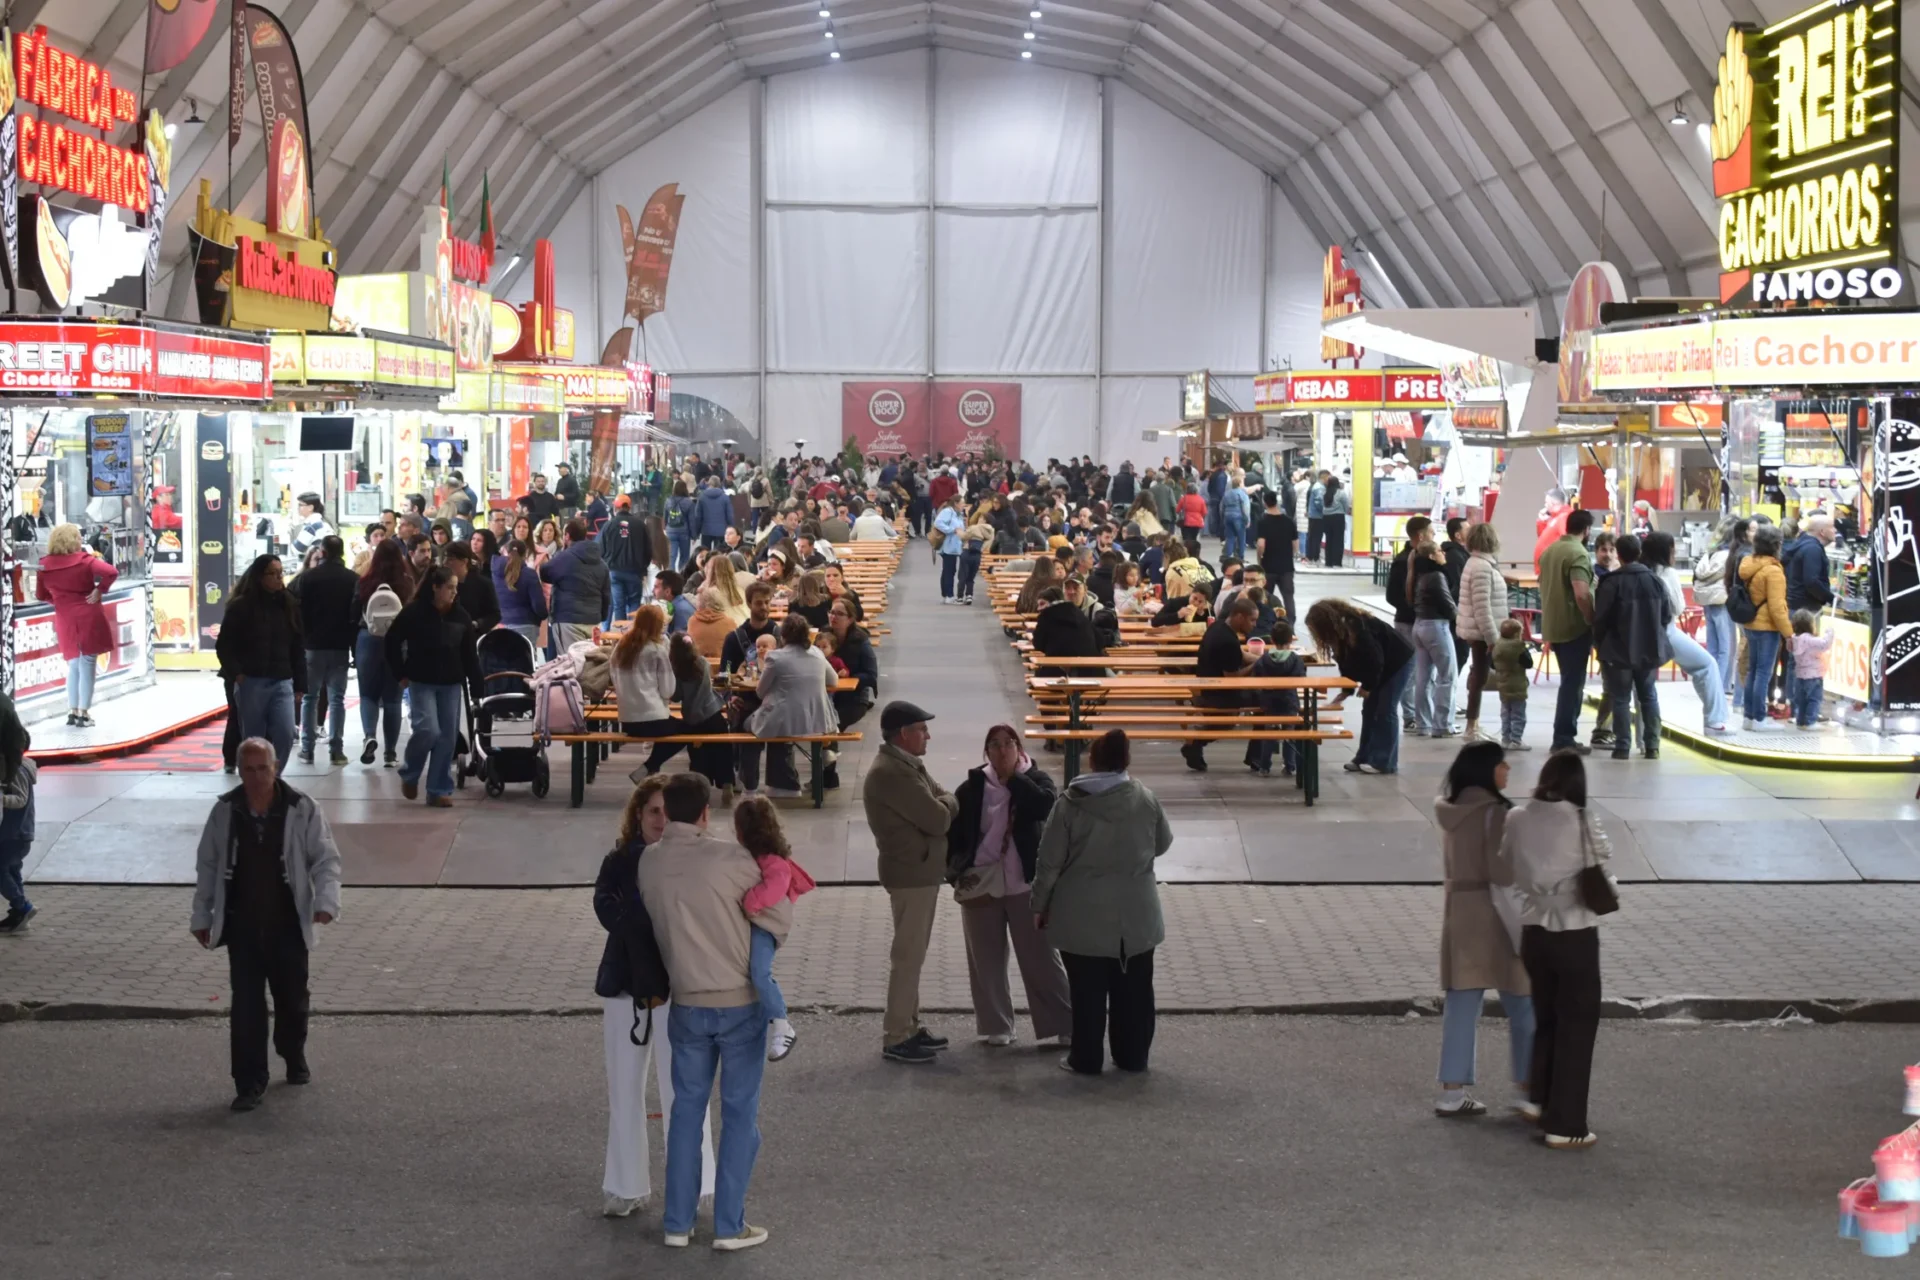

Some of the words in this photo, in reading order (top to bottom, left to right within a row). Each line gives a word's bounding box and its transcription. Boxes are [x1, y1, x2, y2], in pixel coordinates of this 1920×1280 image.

[1778, 13, 1847, 160] REI
[18, 113, 149, 214] CACHORROS
[1719, 163, 1880, 271] CACHORROS
[1752, 268, 1902, 301] FAMOSO
[92, 342, 153, 374] CHIPS
[1716, 337, 1739, 367] Rei
[1754, 334, 1917, 367] Cachorr
[2, 371, 80, 386] Cheddar
[91, 373, 131, 388] Bacon
[1294, 379, 1349, 399] KEBAB
[873, 400, 900, 409] SUPER
[963, 400, 989, 409] SUPER
[965, 408, 988, 416] BOCK
